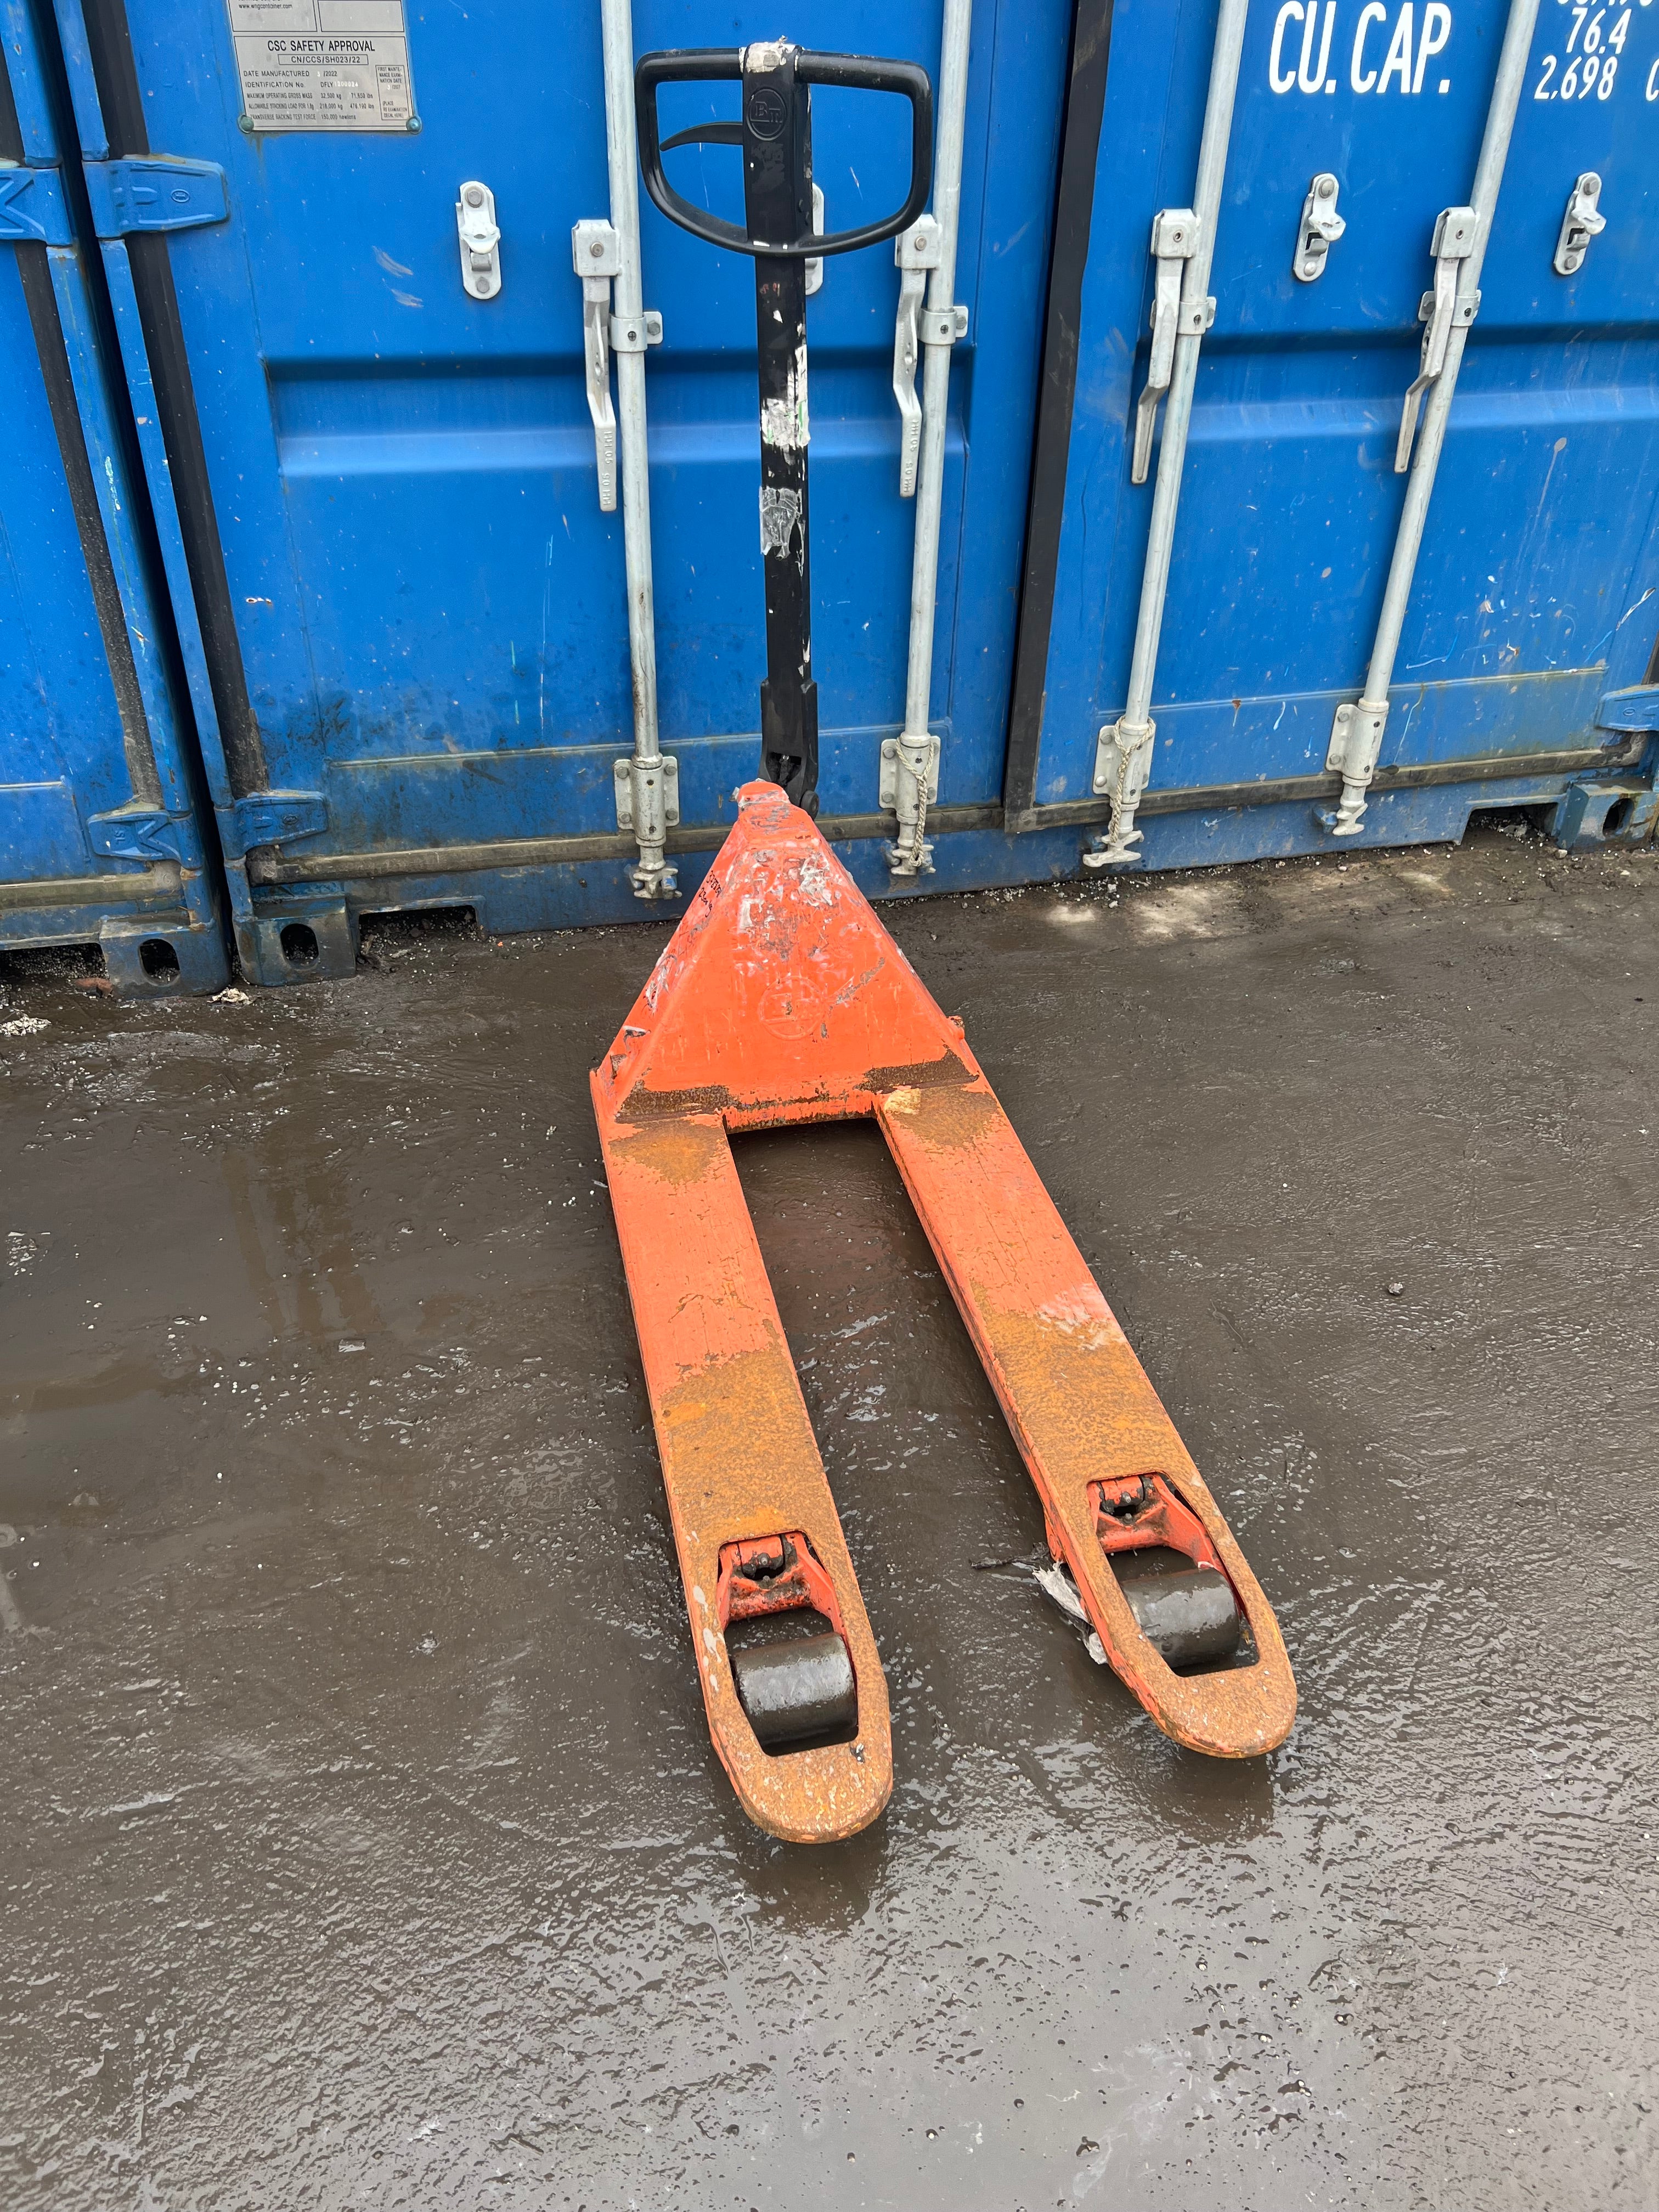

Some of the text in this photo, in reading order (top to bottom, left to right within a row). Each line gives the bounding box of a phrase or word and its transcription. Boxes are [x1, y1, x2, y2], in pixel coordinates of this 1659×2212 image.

[1566, 7, 1632, 54] 76.4
[268, 41, 375, 51] CSC SAFETY APPROVAL
